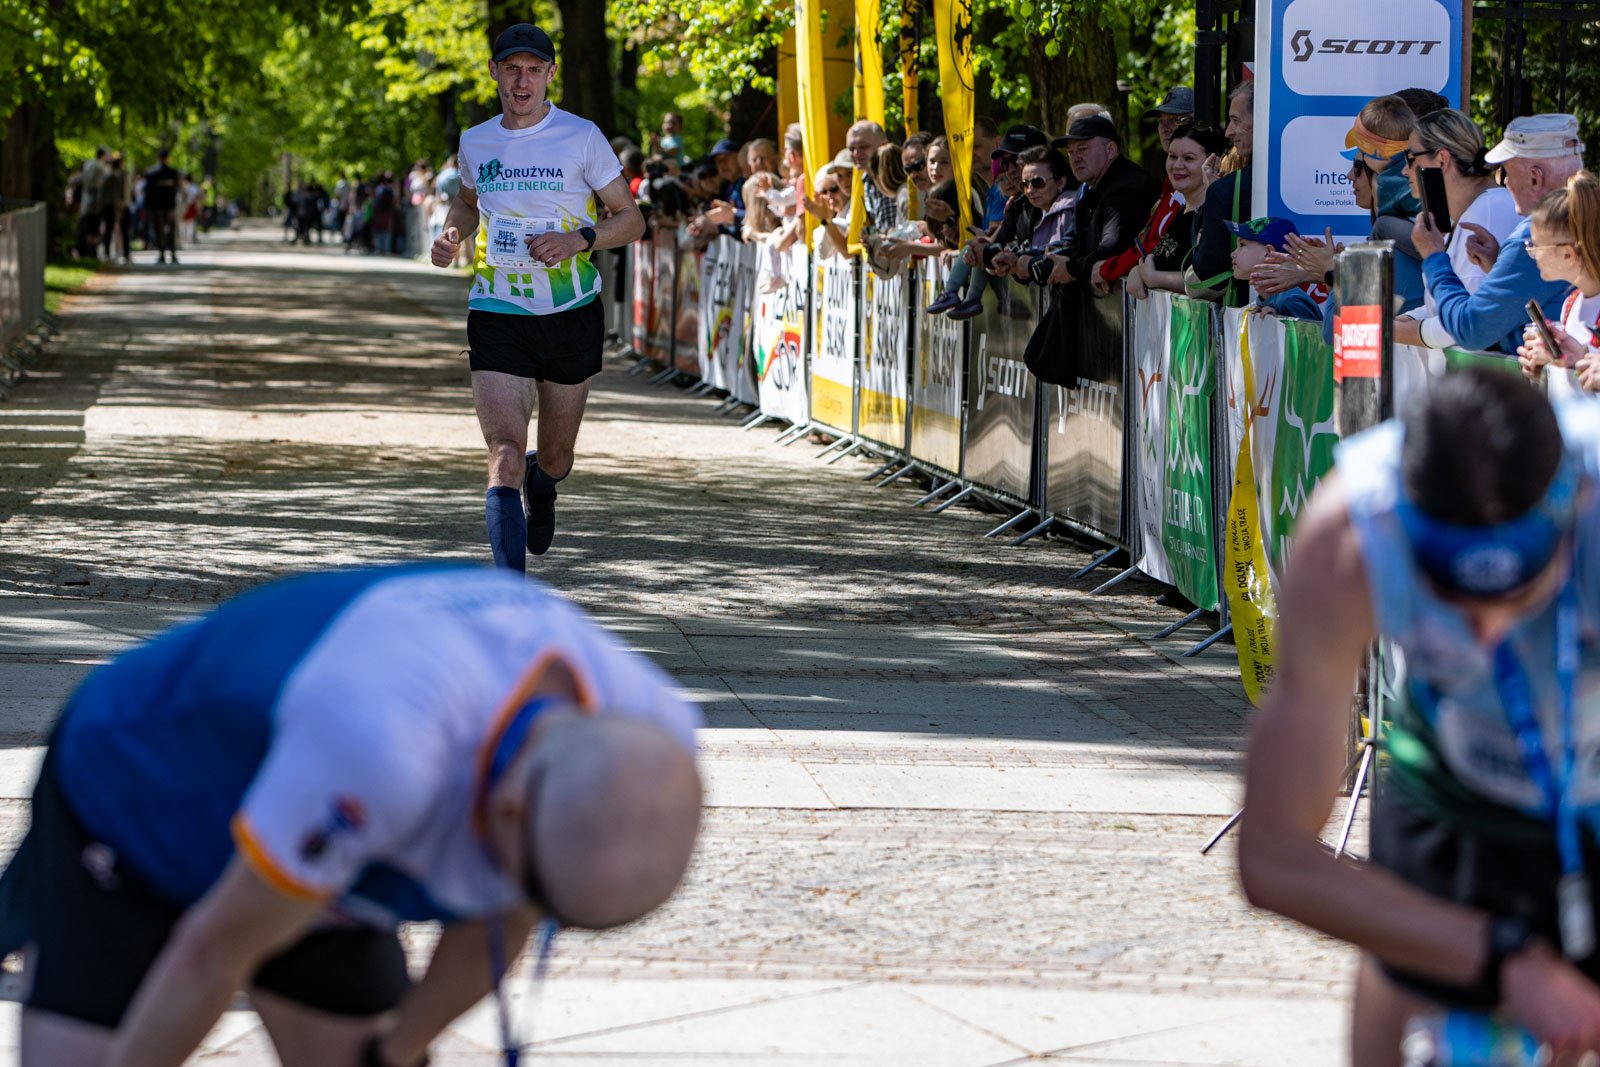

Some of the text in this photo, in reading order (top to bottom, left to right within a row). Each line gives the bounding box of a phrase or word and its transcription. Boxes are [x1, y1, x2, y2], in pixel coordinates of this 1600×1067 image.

[1317, 39, 1442, 55] SCOTT
[504, 166, 564, 178] DRUŻYNA
[476, 181, 564, 194] DOBREJ ENERGII
[1314, 199, 1335, 207] Grupa
[1341, 323, 1381, 347] DATASPORT
[986, 356, 1030, 399] SCOTT
[1068, 376, 1118, 424] SCOTT
[1235, 560, 1247, 589] DOLNY
